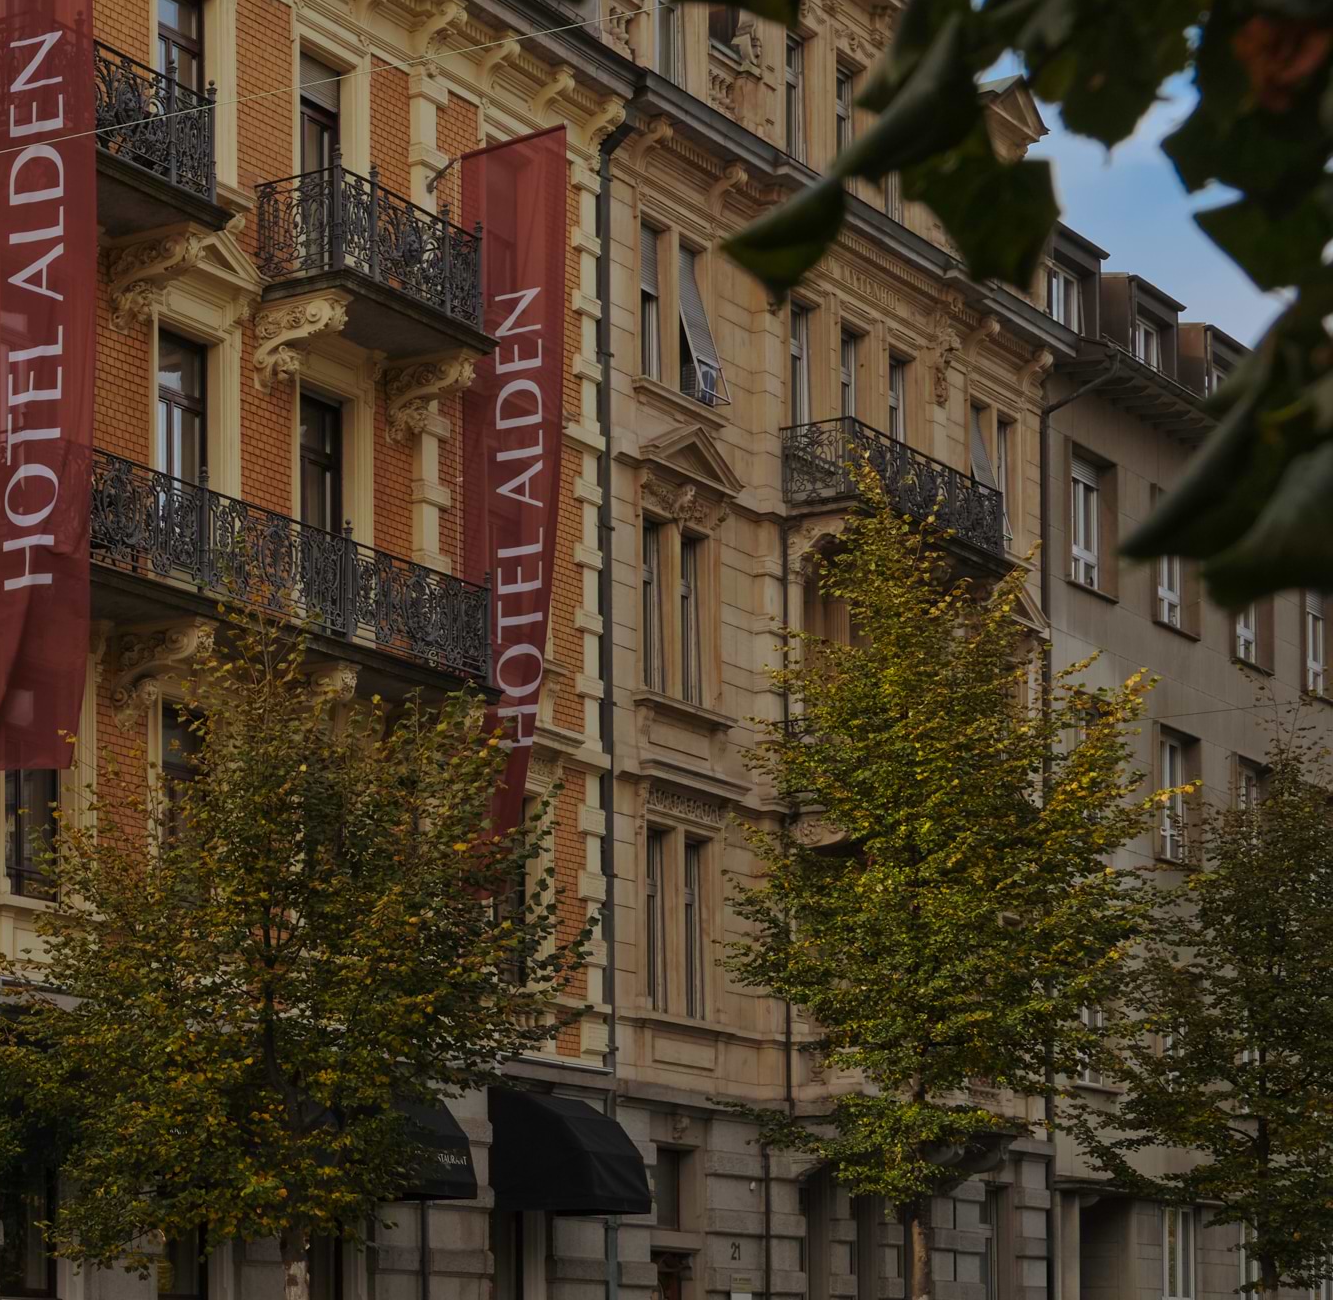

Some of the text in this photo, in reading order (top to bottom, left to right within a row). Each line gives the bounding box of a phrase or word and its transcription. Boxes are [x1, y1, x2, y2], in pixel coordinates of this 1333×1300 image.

[3, 29, 65, 591] HOTEL ALDEN
[495, 286, 544, 748] HOTEL ALDEN
[731, 1242, 741, 1260] 21
